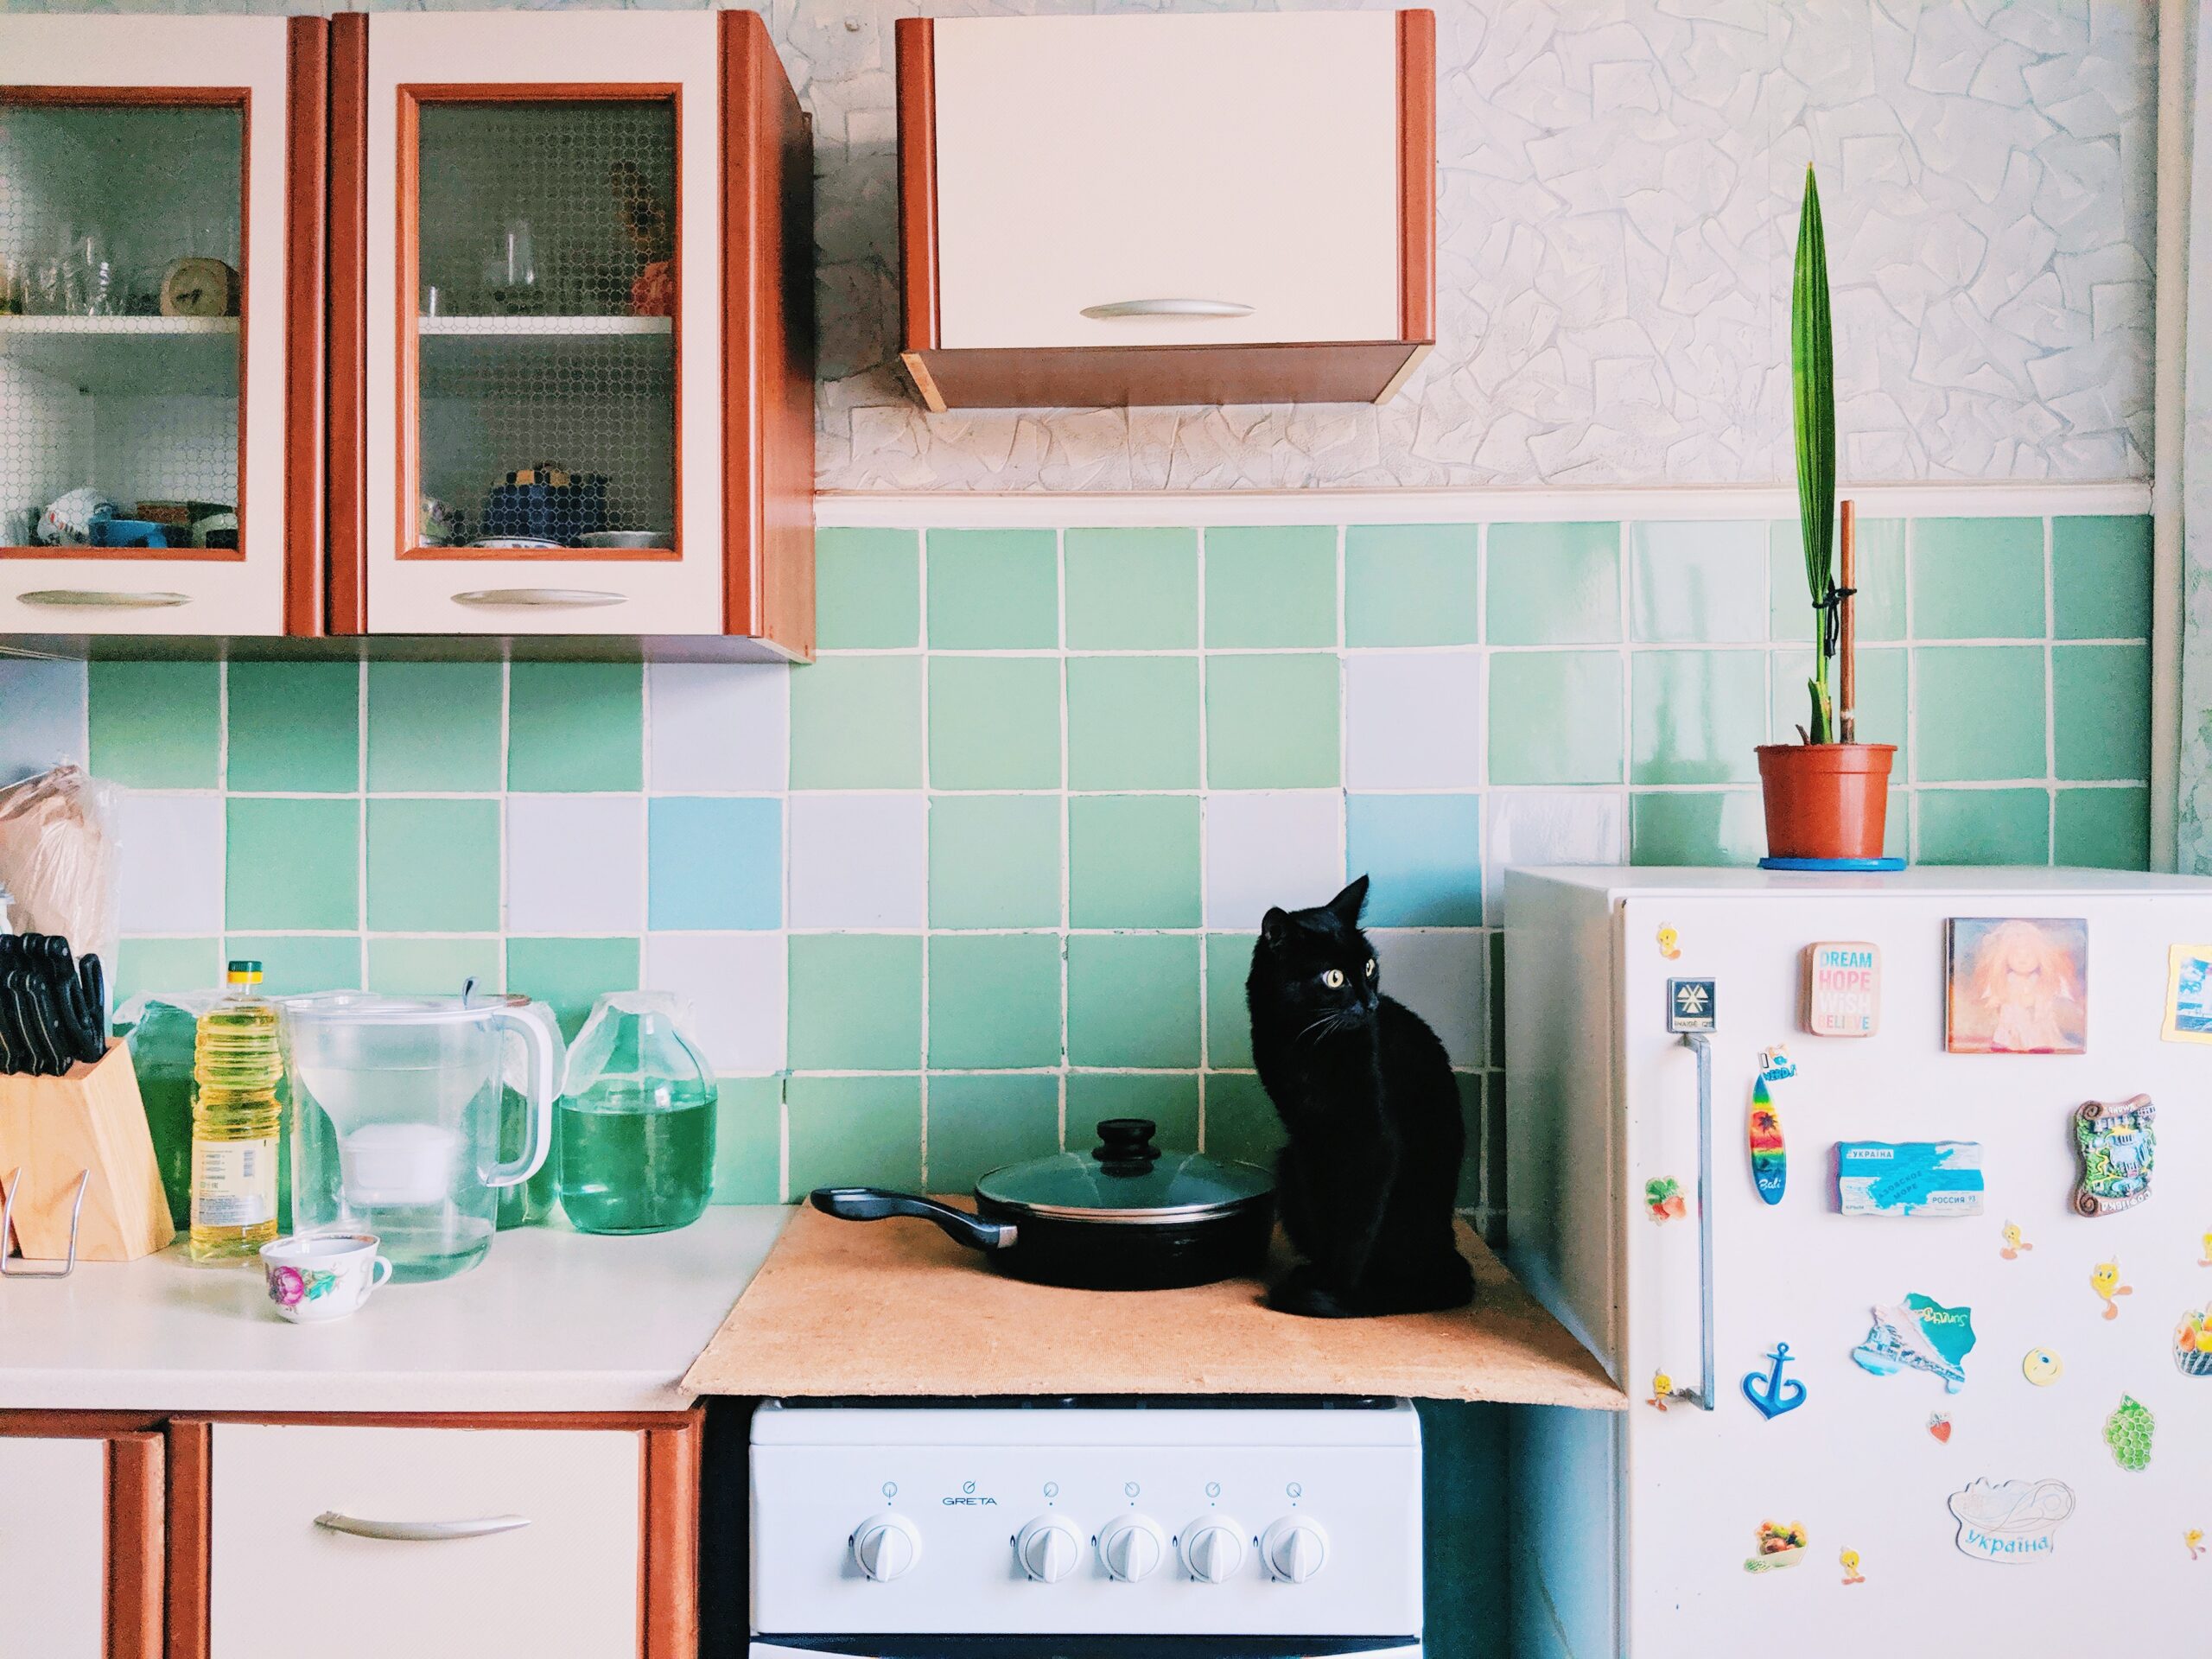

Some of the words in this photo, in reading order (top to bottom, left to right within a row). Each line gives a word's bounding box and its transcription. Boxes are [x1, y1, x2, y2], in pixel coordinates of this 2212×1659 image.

[1820, 951, 1872, 968] DREAM
[1819, 969, 1872, 991] HOPE
[1818, 1014, 1870, 1030] BELIEVE
[1758, 1177, 1782, 1191] Bali
[1893, 1183, 1918, 1199] МОРЕ
[942, 1497, 998, 1505] GRETA
[1965, 1529, 2049, 1555] Україна
